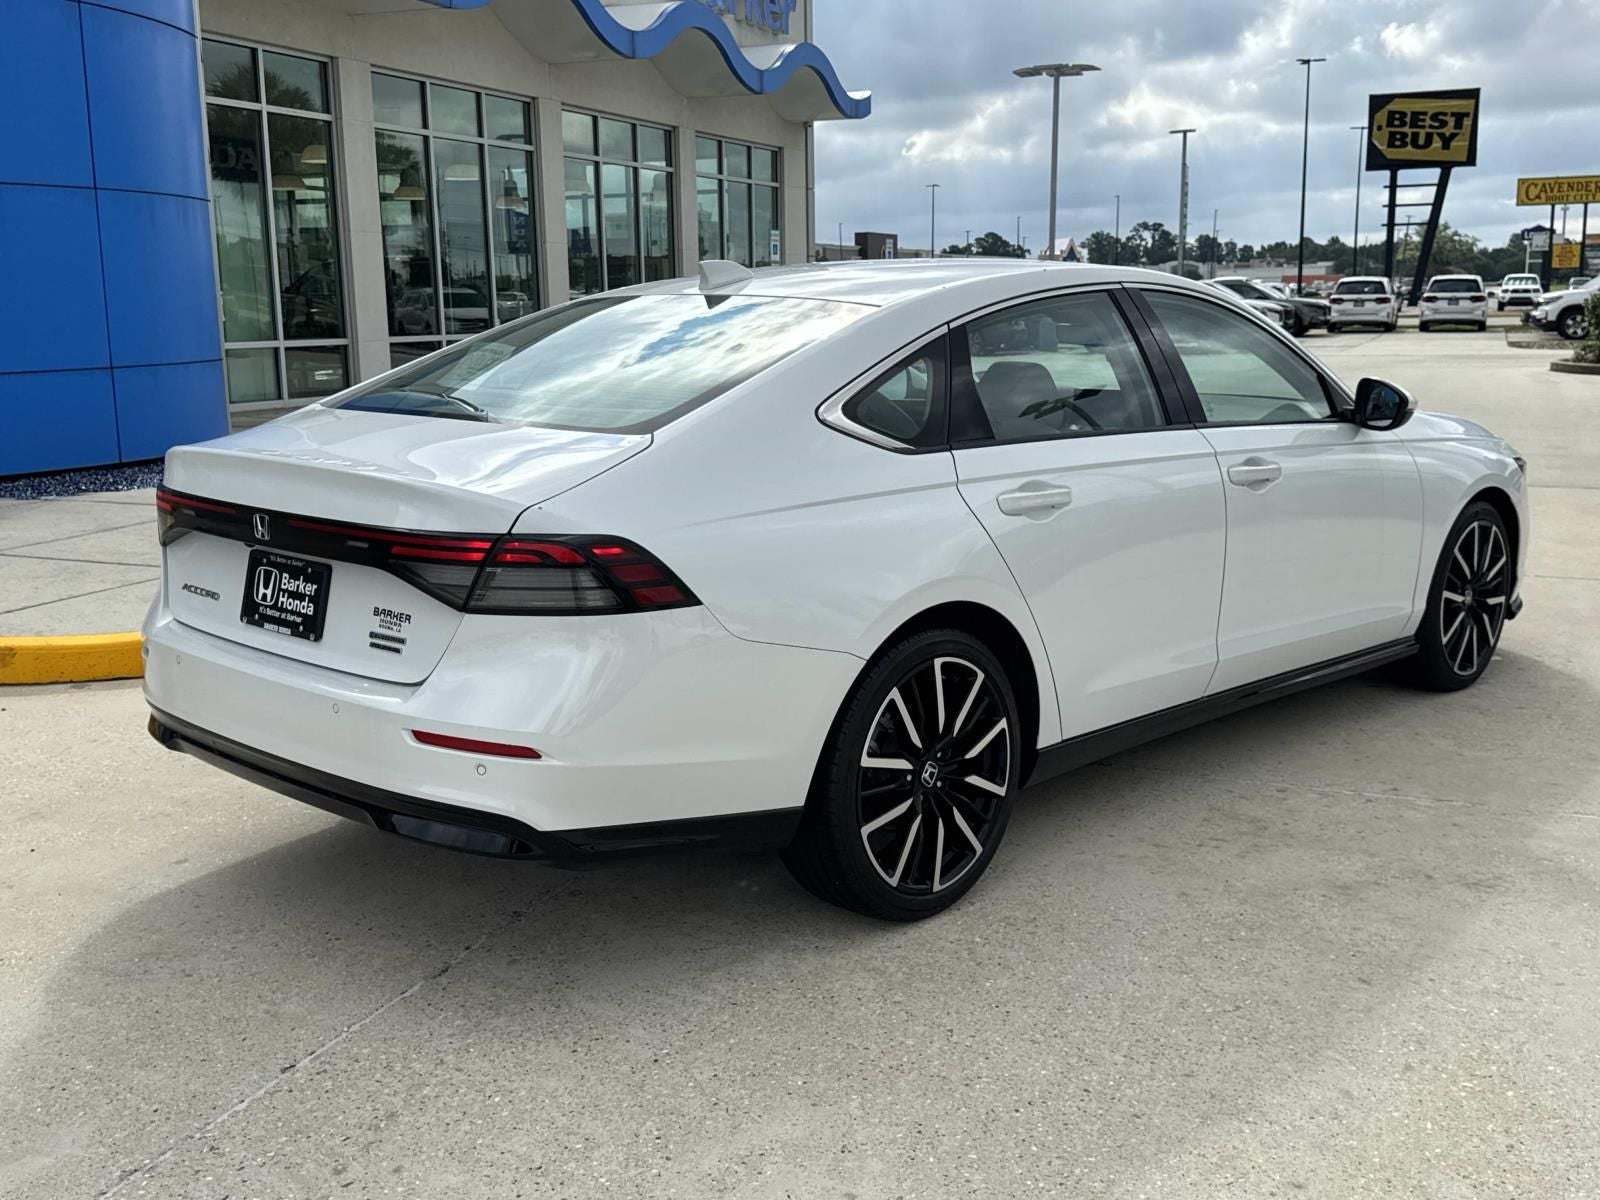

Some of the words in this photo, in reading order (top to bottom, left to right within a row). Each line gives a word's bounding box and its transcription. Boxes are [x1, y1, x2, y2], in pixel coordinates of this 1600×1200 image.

[1385, 110, 1470, 130] BEST
[1386, 131, 1462, 151] BUY
[1545, 193, 1571, 202] BOOT
[1573, 192, 1597, 201] CITY
[182, 583, 221, 601] ACCORD
[281, 573, 318, 596] Barker
[278, 591, 314, 615] Honda
[281, 611, 287, 619] at
[373, 606, 411, 624] BARKER
[379, 618, 402, 628] HONDA
